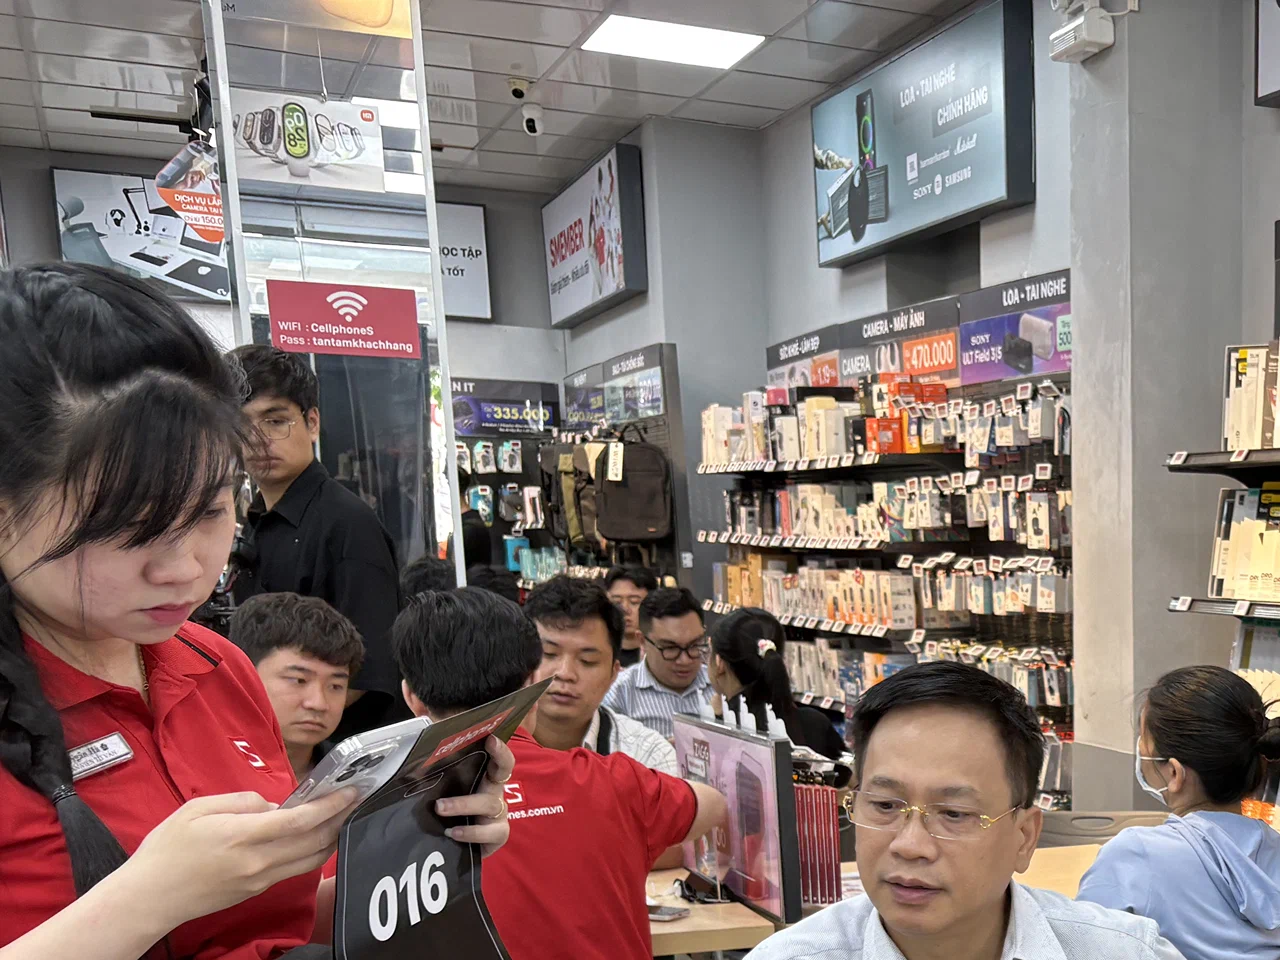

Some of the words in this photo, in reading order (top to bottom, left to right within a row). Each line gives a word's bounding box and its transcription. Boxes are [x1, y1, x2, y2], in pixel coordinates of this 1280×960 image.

[899, 88, 916, 108] LOA
[919, 72, 934, 98] TAI
[934, 63, 956, 95] NGHE
[937, 98, 965, 126] CHÍNH
[964, 85, 988, 116] HÃNG
[945, 166, 972, 188] SAMSUNG
[913, 182, 932, 200] SONY
[550, 217, 585, 268] SMEMBER
[460, 246, 482, 260] TẬP
[447, 266, 465, 277] TỐT
[1002, 288, 1020, 306] LOA
[1025, 283, 1039, 302] TAI
[1040, 277, 1067, 300] NGHE
[278, 320, 301, 332] WIFI
[311, 322, 374, 336] CellphoneS
[862, 319, 889, 338] CAMERA
[279, 334, 305, 345] Pass
[312, 336, 413, 353] tantamkhachhang
[970, 333, 990, 346] SONY
[910, 340, 953, 370] 470.000
[842, 355, 871, 376] CAMERA
[493, 406, 550, 421] 335.000
[368, 850, 449, 942] 016
